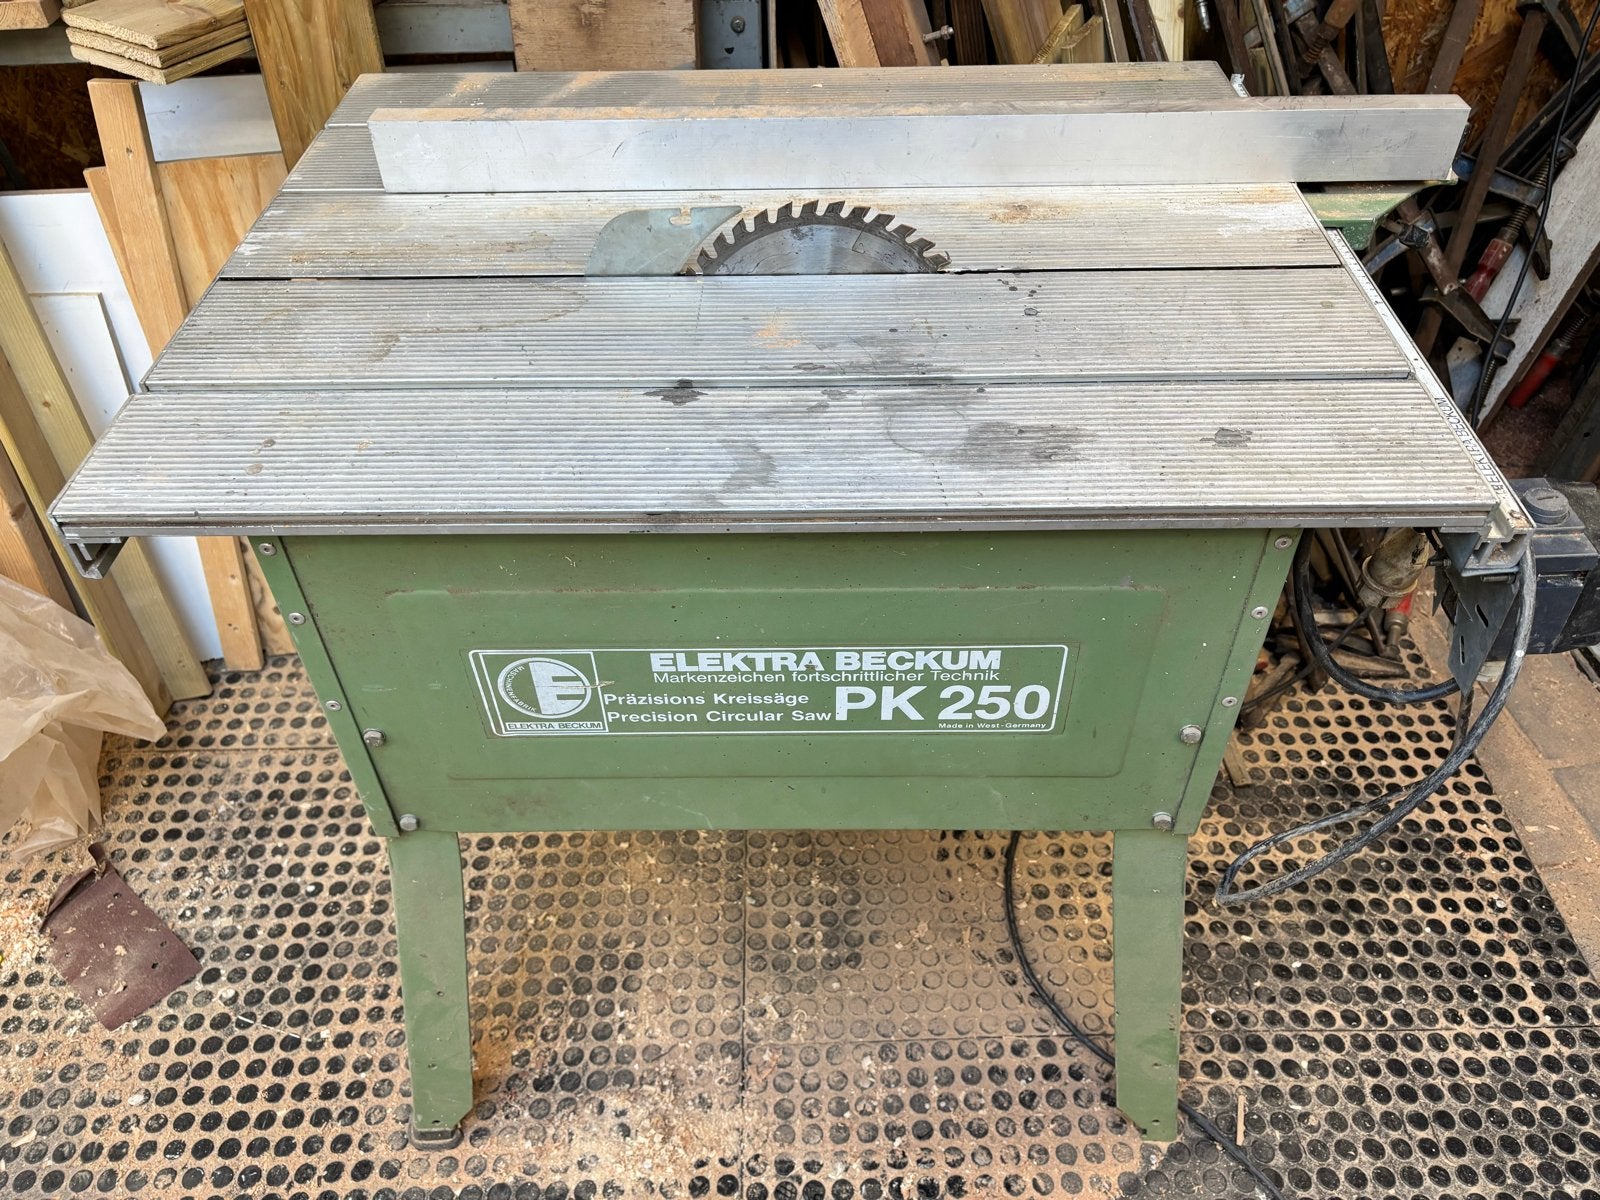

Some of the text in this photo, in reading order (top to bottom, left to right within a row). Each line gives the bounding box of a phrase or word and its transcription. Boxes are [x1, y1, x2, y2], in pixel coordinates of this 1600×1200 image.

[1434, 397, 1470, 437] BECKUM
[650, 650, 1002, 672] ELEKTRA BECKUM
[653, 670, 1000, 683] Markenzeichen fortschrittlicher Technik
[504, 665, 537, 713] MASCHINENFABRIK
[603, 692, 809, 706] Präzisions Kreissäge
[835, 684, 1050, 721] PK 250
[607, 710, 831, 723] Precision Circular Saw
[507, 722, 601, 730] ELEKTRA BECKUM
